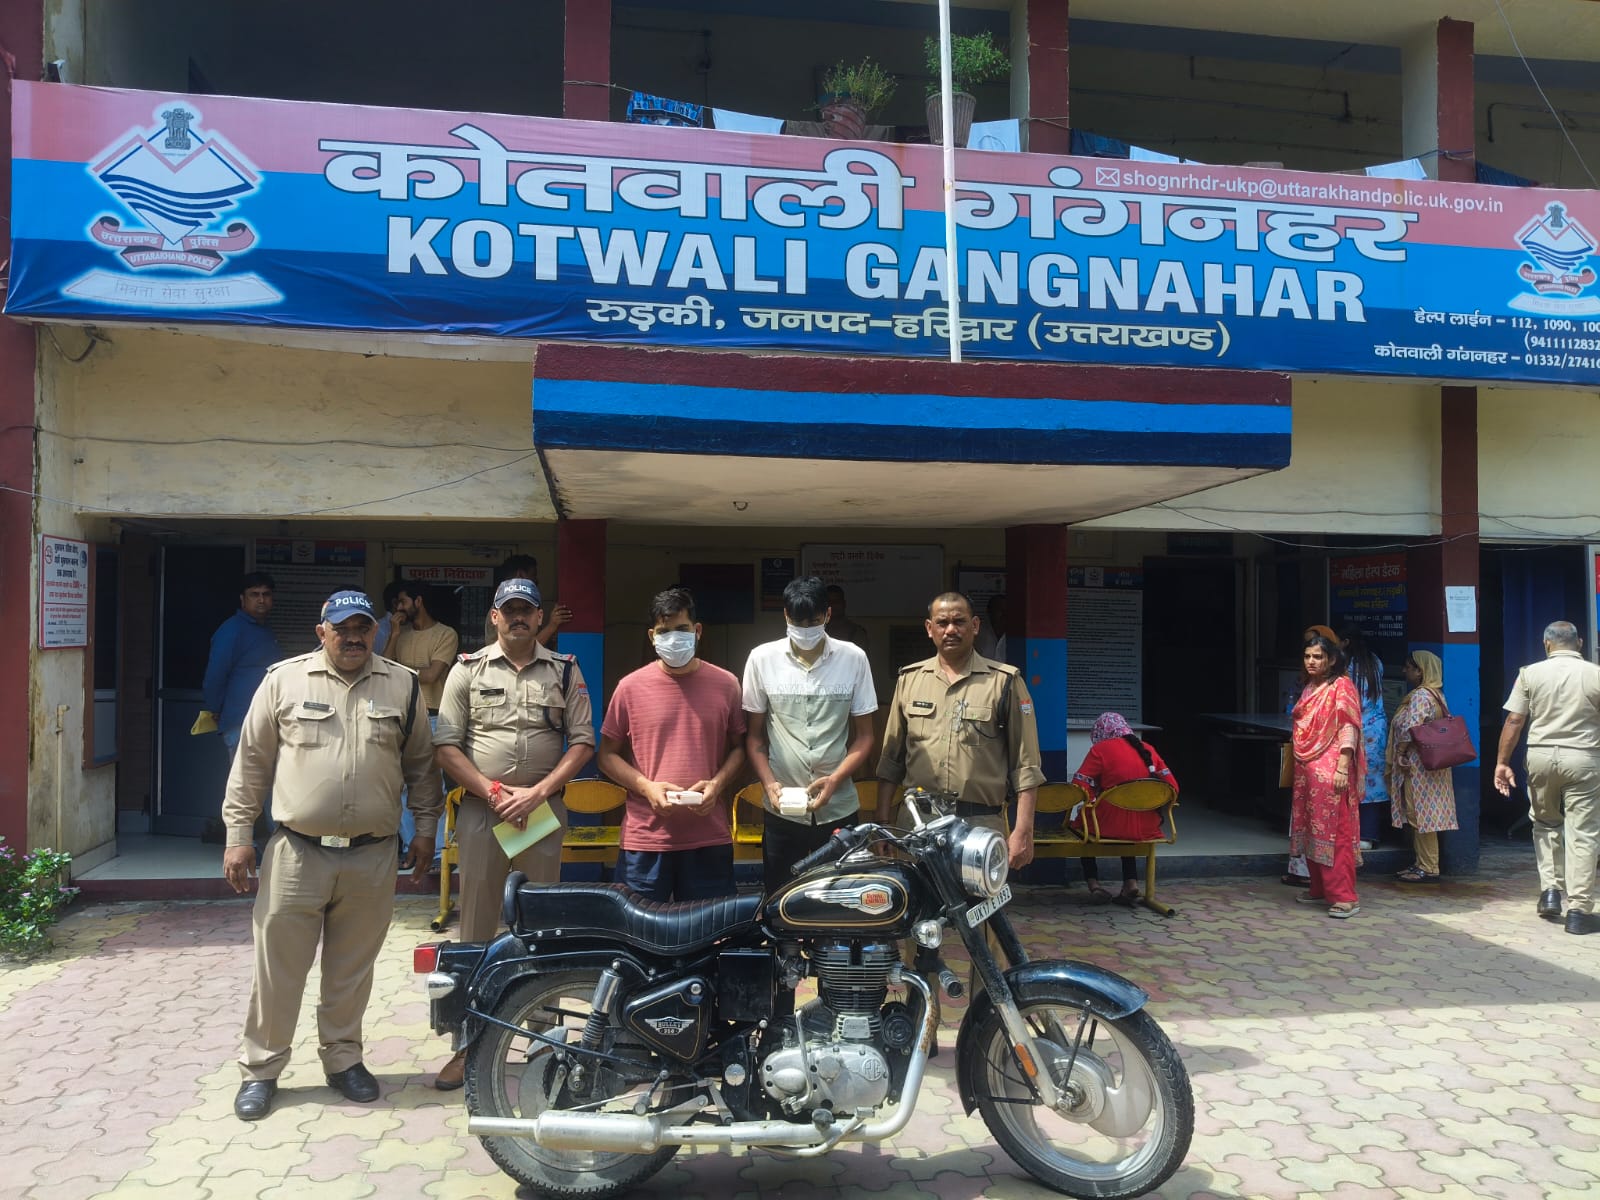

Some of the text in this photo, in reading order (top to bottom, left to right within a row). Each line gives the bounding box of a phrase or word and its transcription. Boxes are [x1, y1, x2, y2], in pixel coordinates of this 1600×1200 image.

[318, 123, 1419, 263] कोतवाली गंगनहर
[1122, 169, 1504, 213] shognrhdr-ukp@uttarakhandpolic.uk.gov.in
[129, 251, 216, 268] UTTARAKHAND POLICE
[387, 215, 1368, 323] KOTWALI GANGNAHAR
[1414, 307, 1445, 325] हेल्प
[1449, 309, 1491, 328] लाईन
[1511, 316, 1538, 331] 112,
[1543, 318, 1577, 333] 1090,
[1027, 312, 1232, 358] (उत्तराखण्ड)
[1374, 341, 1443, 361] कोतवाली
[1446, 345, 1508, 364] गंगनहर
[503, 584, 532, 594] POLICE
[335, 596, 372, 609] POLICE
